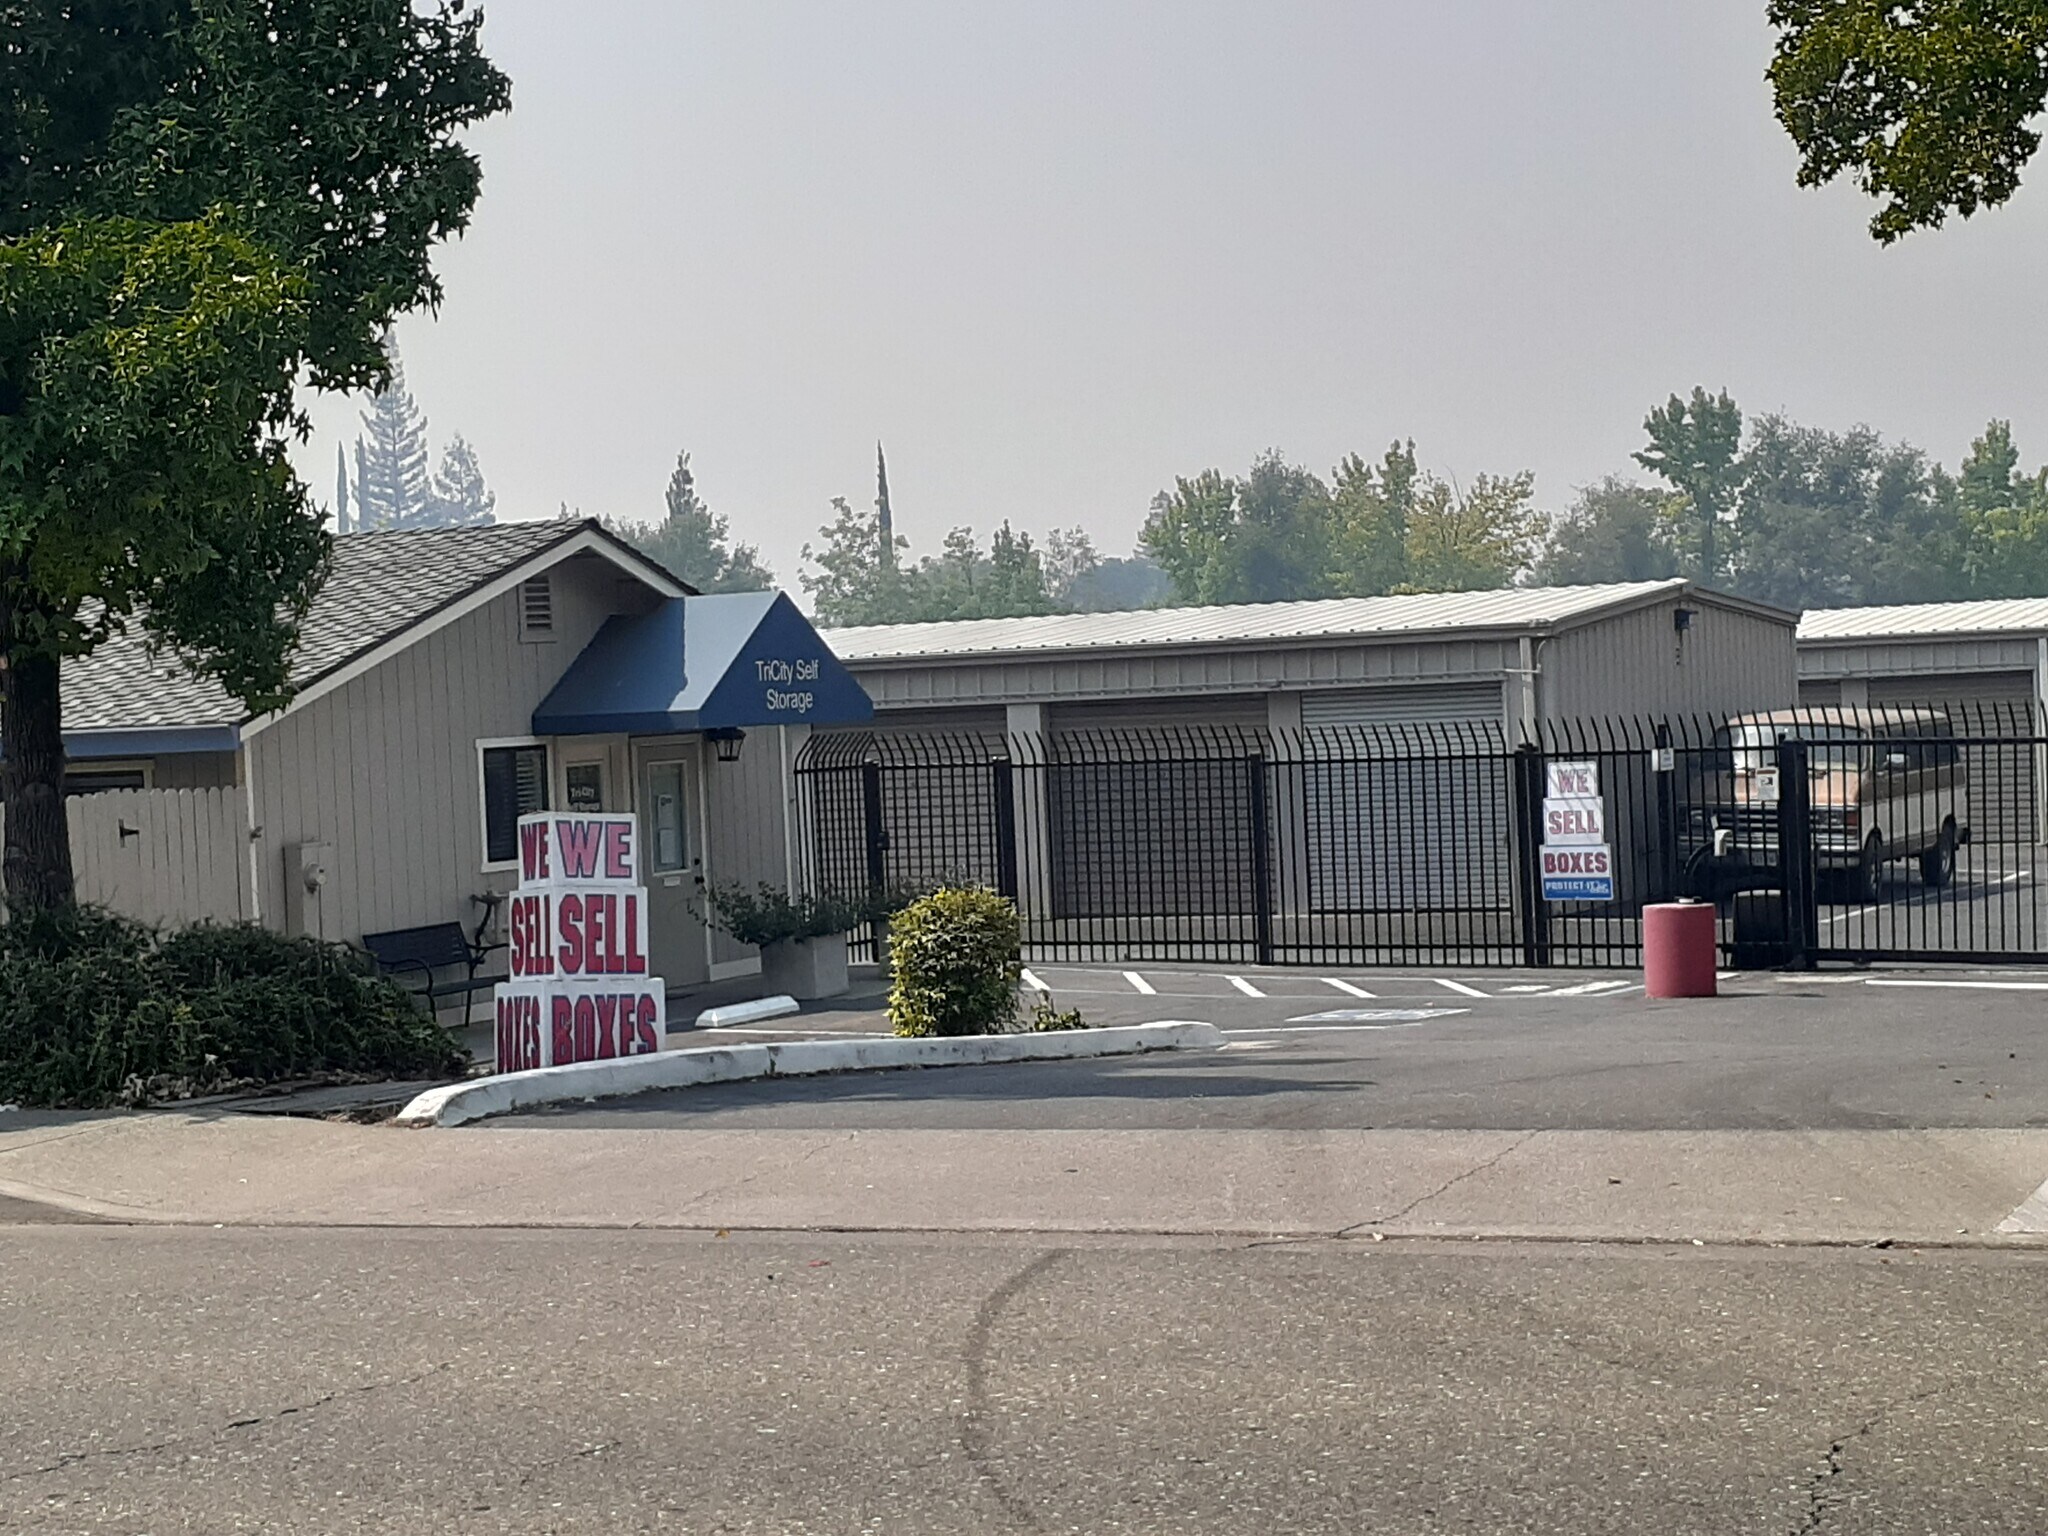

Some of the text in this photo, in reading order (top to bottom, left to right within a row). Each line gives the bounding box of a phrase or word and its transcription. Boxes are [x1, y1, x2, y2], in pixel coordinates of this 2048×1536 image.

[755, 659, 819, 685] TriCity Self
[766, 689, 813, 713] Storage
[1557, 769, 1589, 793] WE
[556, 820, 632, 878] WE
[1548, 810, 1599, 834] SELL
[520, 822, 549, 881] WE
[1544, 852, 1607, 873] BOXES
[511, 895, 554, 976] SELL
[558, 894, 645, 974] SELL
[497, 996, 540, 1073] BOXES
[552, 993, 657, 1066] BOXES
